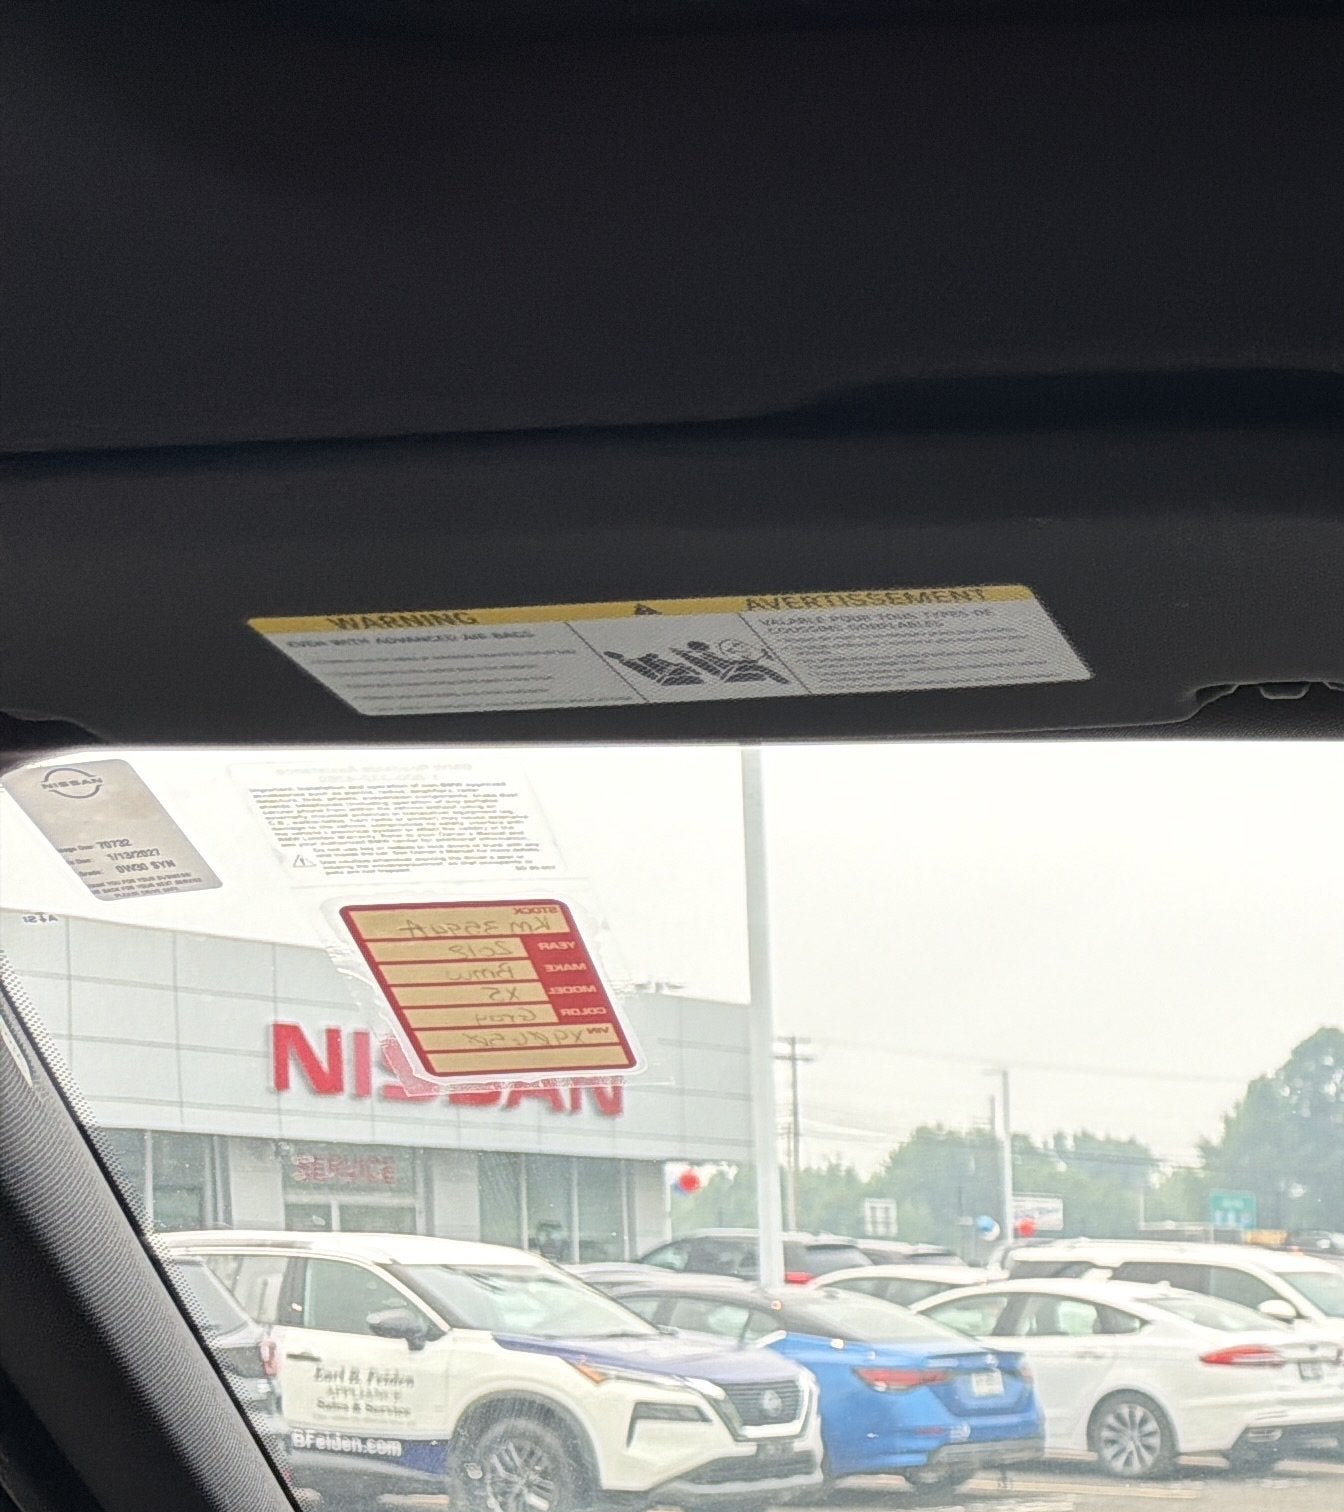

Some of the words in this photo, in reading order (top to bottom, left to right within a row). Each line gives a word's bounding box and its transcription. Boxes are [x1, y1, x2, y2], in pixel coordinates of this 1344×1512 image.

[746, 589, 986, 612] AVERTISSEMENT
[329, 612, 480, 630] WARNING
[41, 777, 104, 790] NISSAN
[150, 860, 176, 869] SYN
